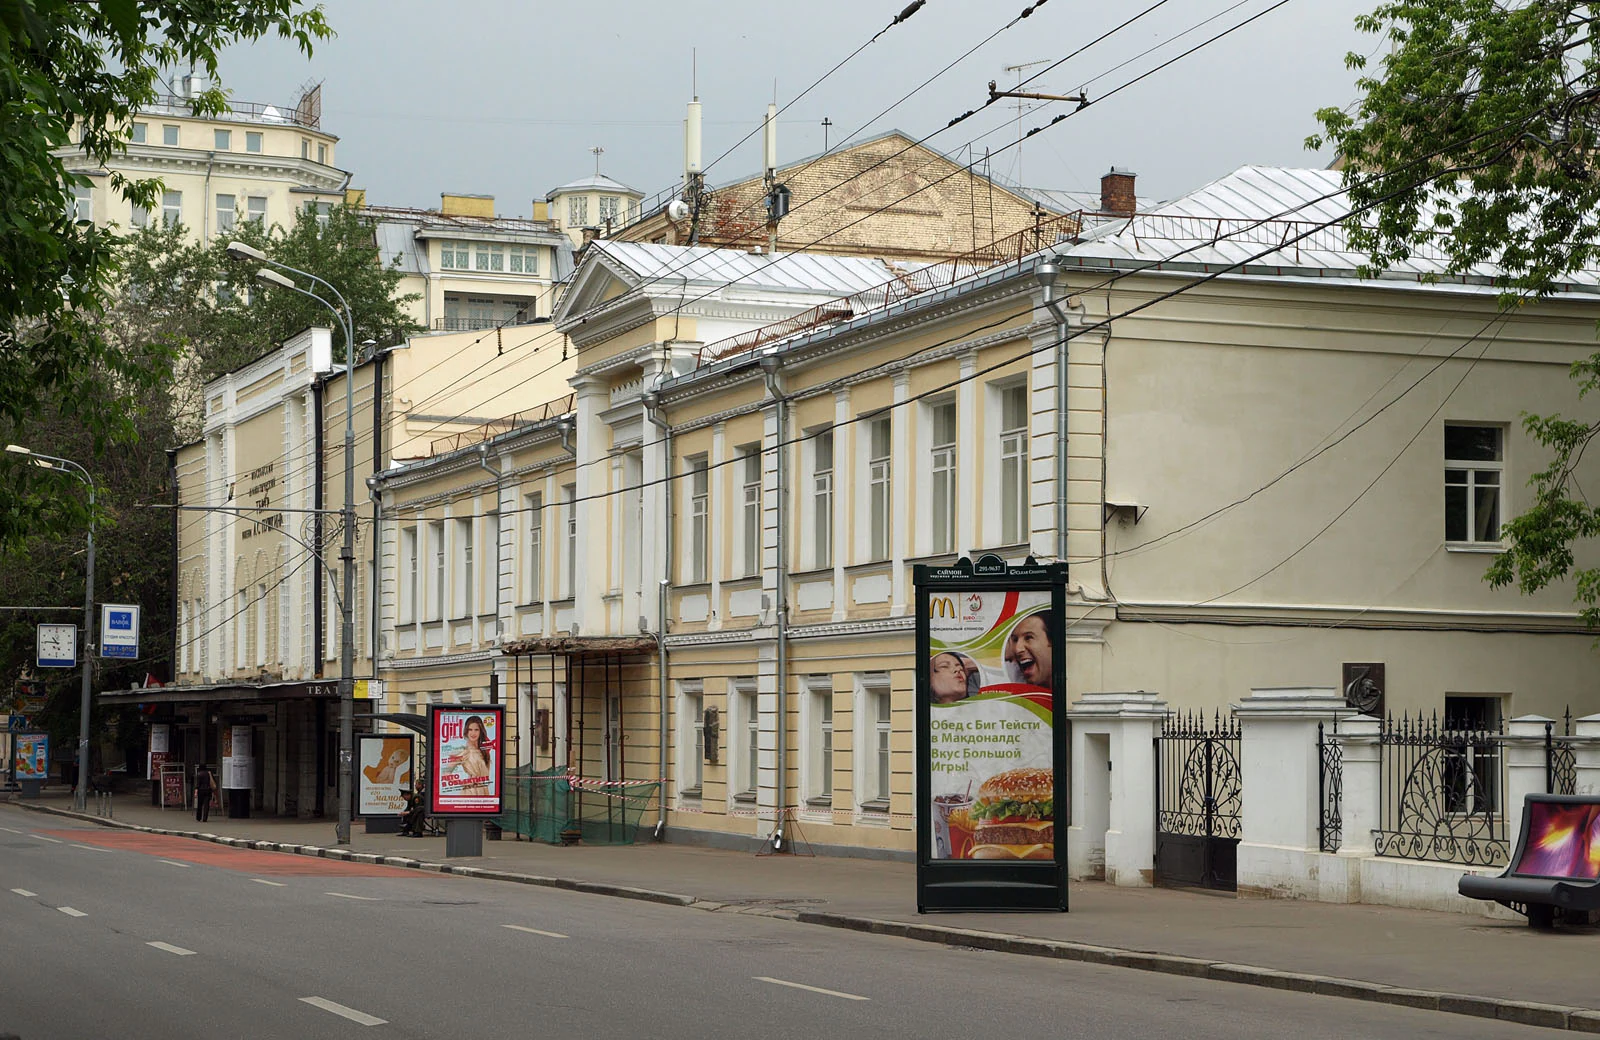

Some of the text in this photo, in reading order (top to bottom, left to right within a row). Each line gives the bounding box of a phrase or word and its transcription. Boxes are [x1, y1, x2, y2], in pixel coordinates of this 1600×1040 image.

[441, 718, 464, 743] girl
[931, 719, 1041, 732] Обед с Биг Тейсти
[931, 732, 1021, 745] в Макдоналдс
[931, 748, 1022, 761] Вкус Большой
[931, 761, 969, 774] Игры!
